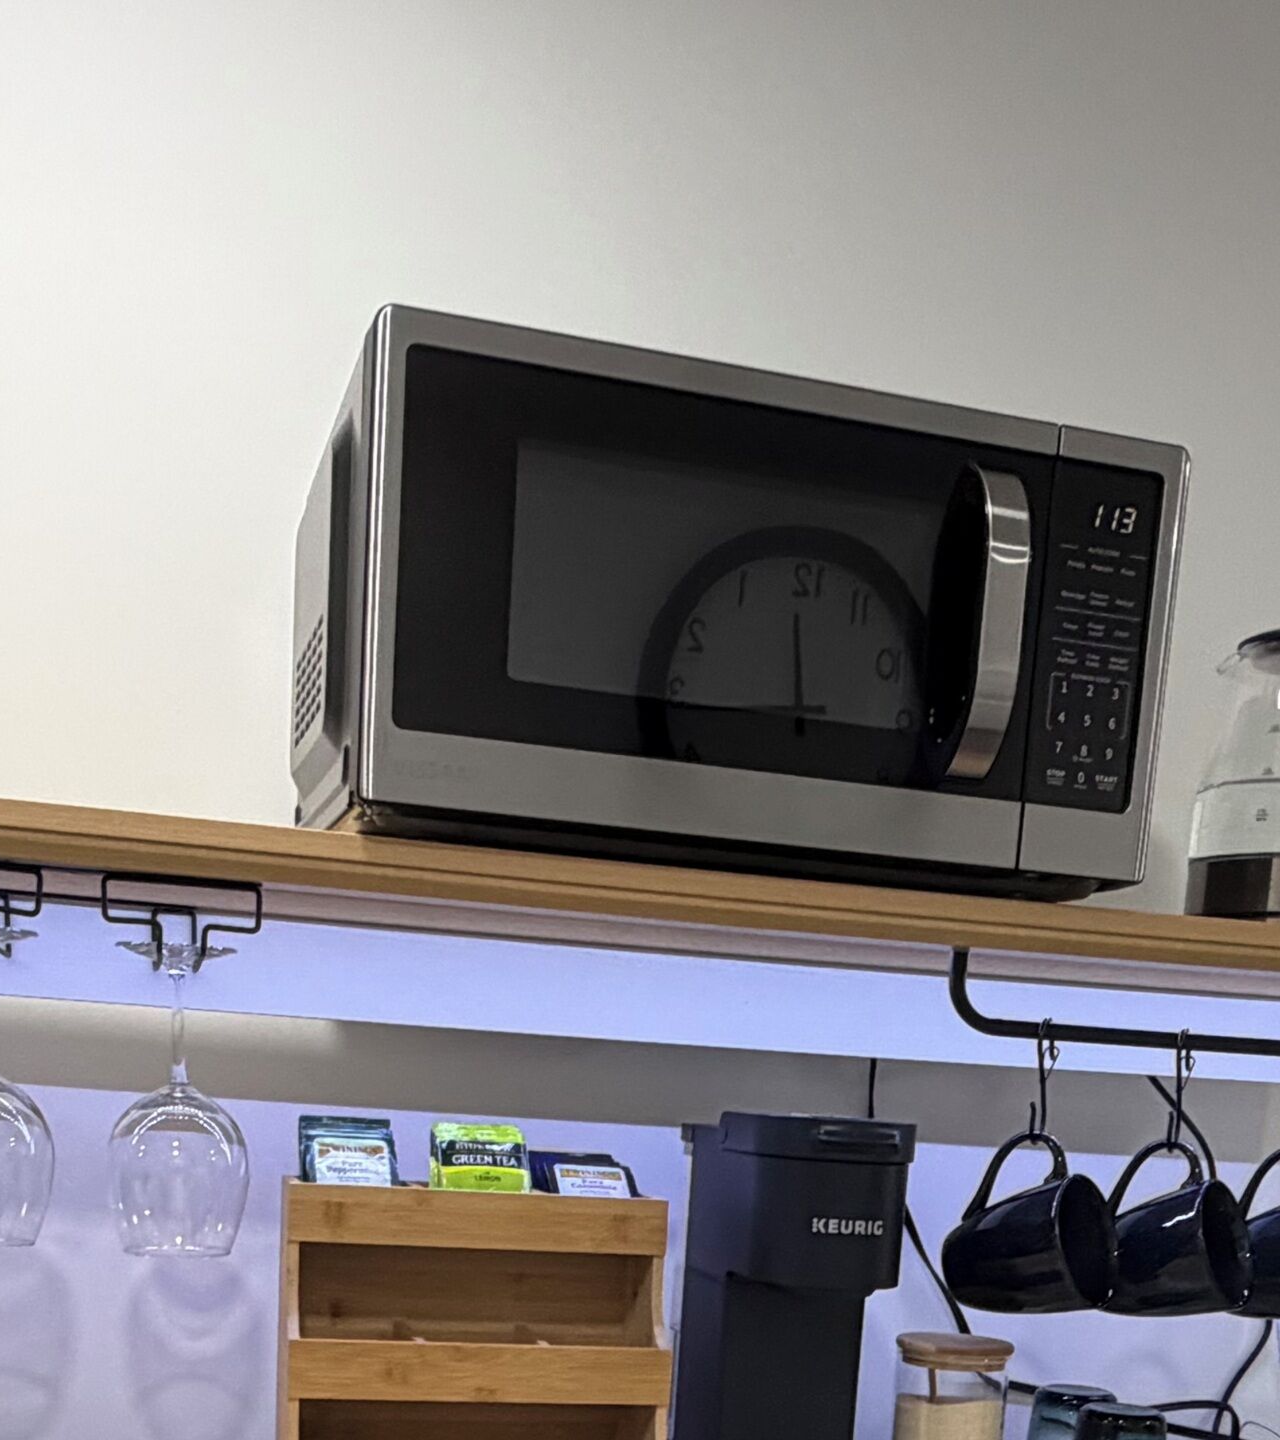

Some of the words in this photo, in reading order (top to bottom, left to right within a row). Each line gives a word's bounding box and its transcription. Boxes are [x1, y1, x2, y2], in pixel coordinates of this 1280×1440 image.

[1061, 681, 1068, 694] 1
[1086, 684, 1094, 697] 2
[1111, 687, 1119, 700] 3
[1057, 711, 1066, 724] 4
[1083, 714, 1092, 727] 5
[1108, 717, 1116, 730] 6
[1055, 741, 1063, 754] 7
[1080, 744, 1088, 757] 8
[1105, 747, 1114, 761] 9
[1046, 768, 1066, 778] STOP
[1077, 771, 1085, 784] 0
[1095, 774, 1119, 784] START
[451, 1154, 493, 1165] GREEN
[495, 1155, 519, 1168] TEA
[474, 1174, 502, 1183] LEMON
[811, 1216, 884, 1236] KEURIG
